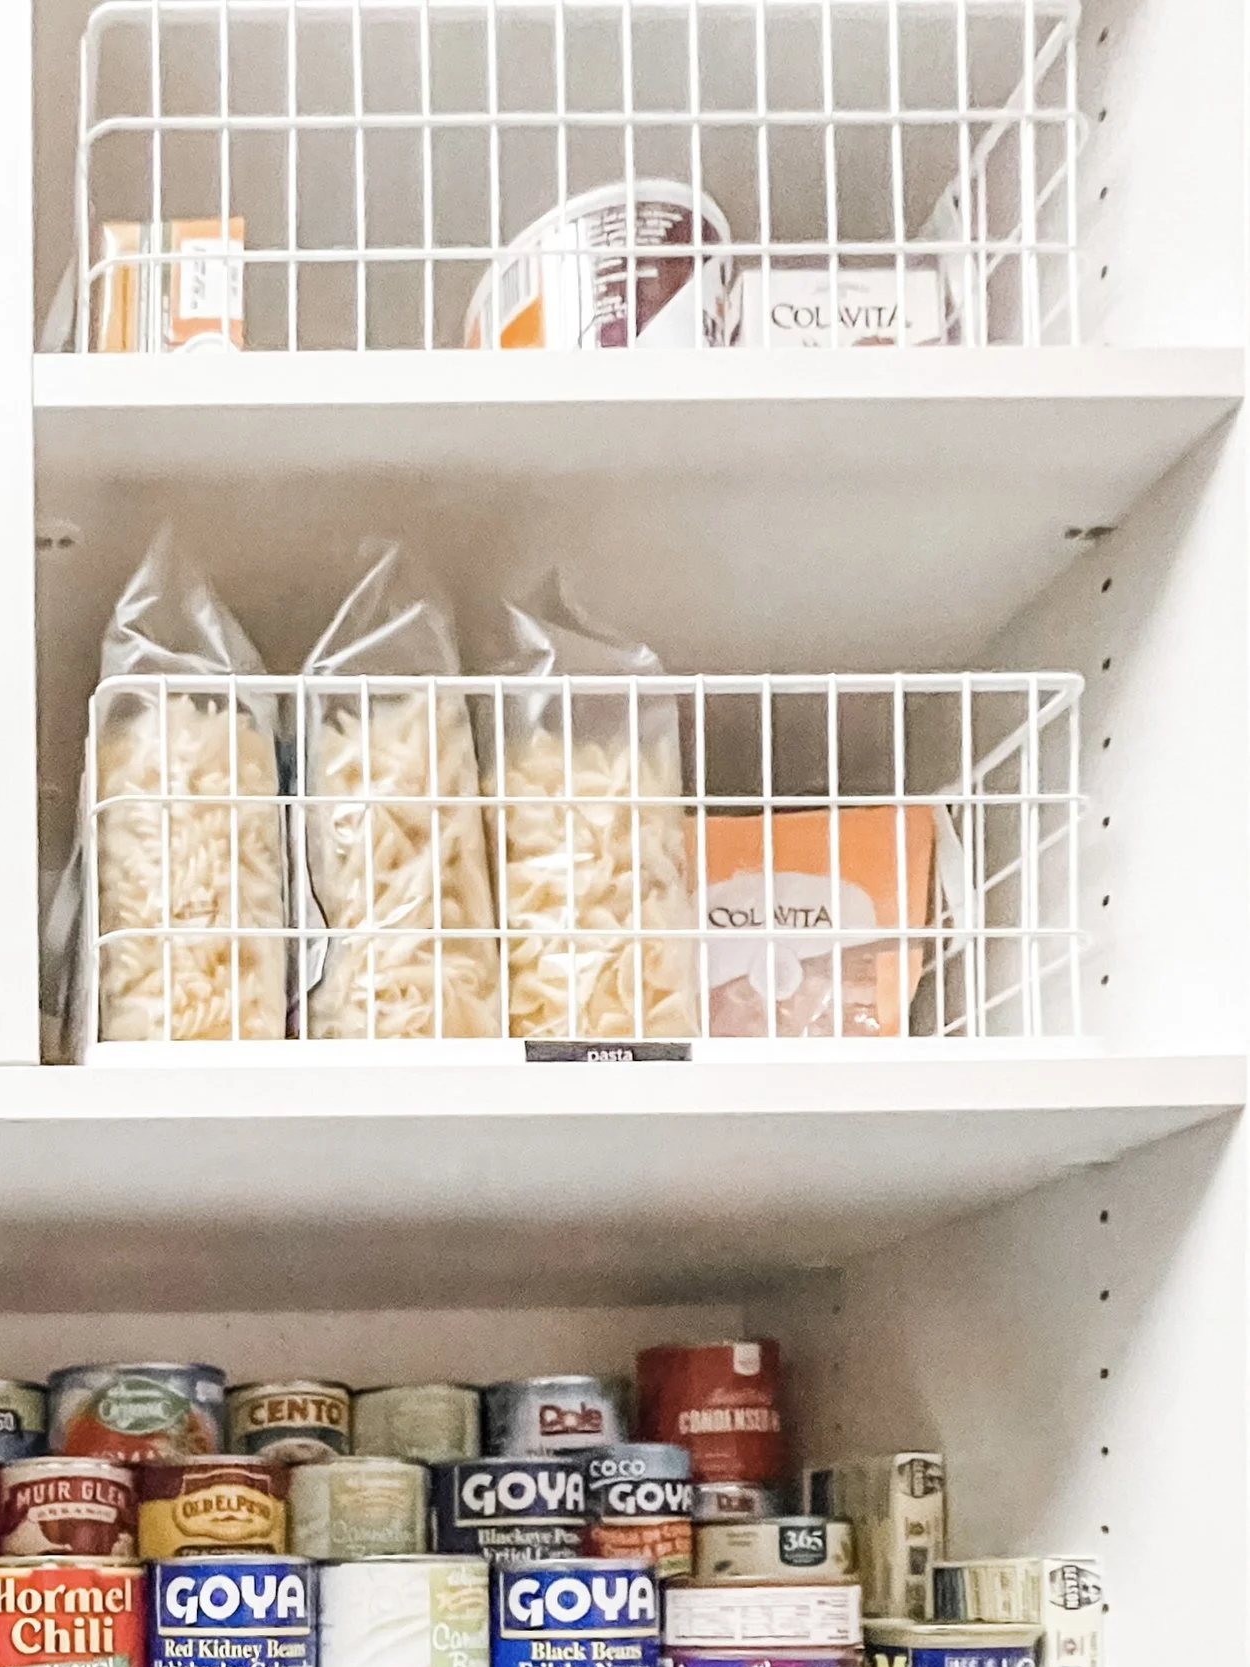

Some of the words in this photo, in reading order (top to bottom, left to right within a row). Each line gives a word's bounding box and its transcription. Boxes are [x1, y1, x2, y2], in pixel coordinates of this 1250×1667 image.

[250, 1399, 342, 1426] CENTO
[539, 1401, 603, 1431] Dole
[589, 1460, 646, 1477] COCO
[16, 1481, 72, 1510] MUIR
[460, 1470, 586, 1516] GOYA
[608, 1482, 693, 1515] GOYA
[783, 1530, 823, 1552] 365
[166, 1574, 306, 1624] GOYA
[508, 1576, 656, 1628] GOYA
[11, 1616, 114, 1655] Chili
[531, 1640, 588, 1660] Black
[591, 1640, 643, 1660] Beans
[165, 1638, 194, 1658] Red
[198, 1639, 262, 1663] Kidney
